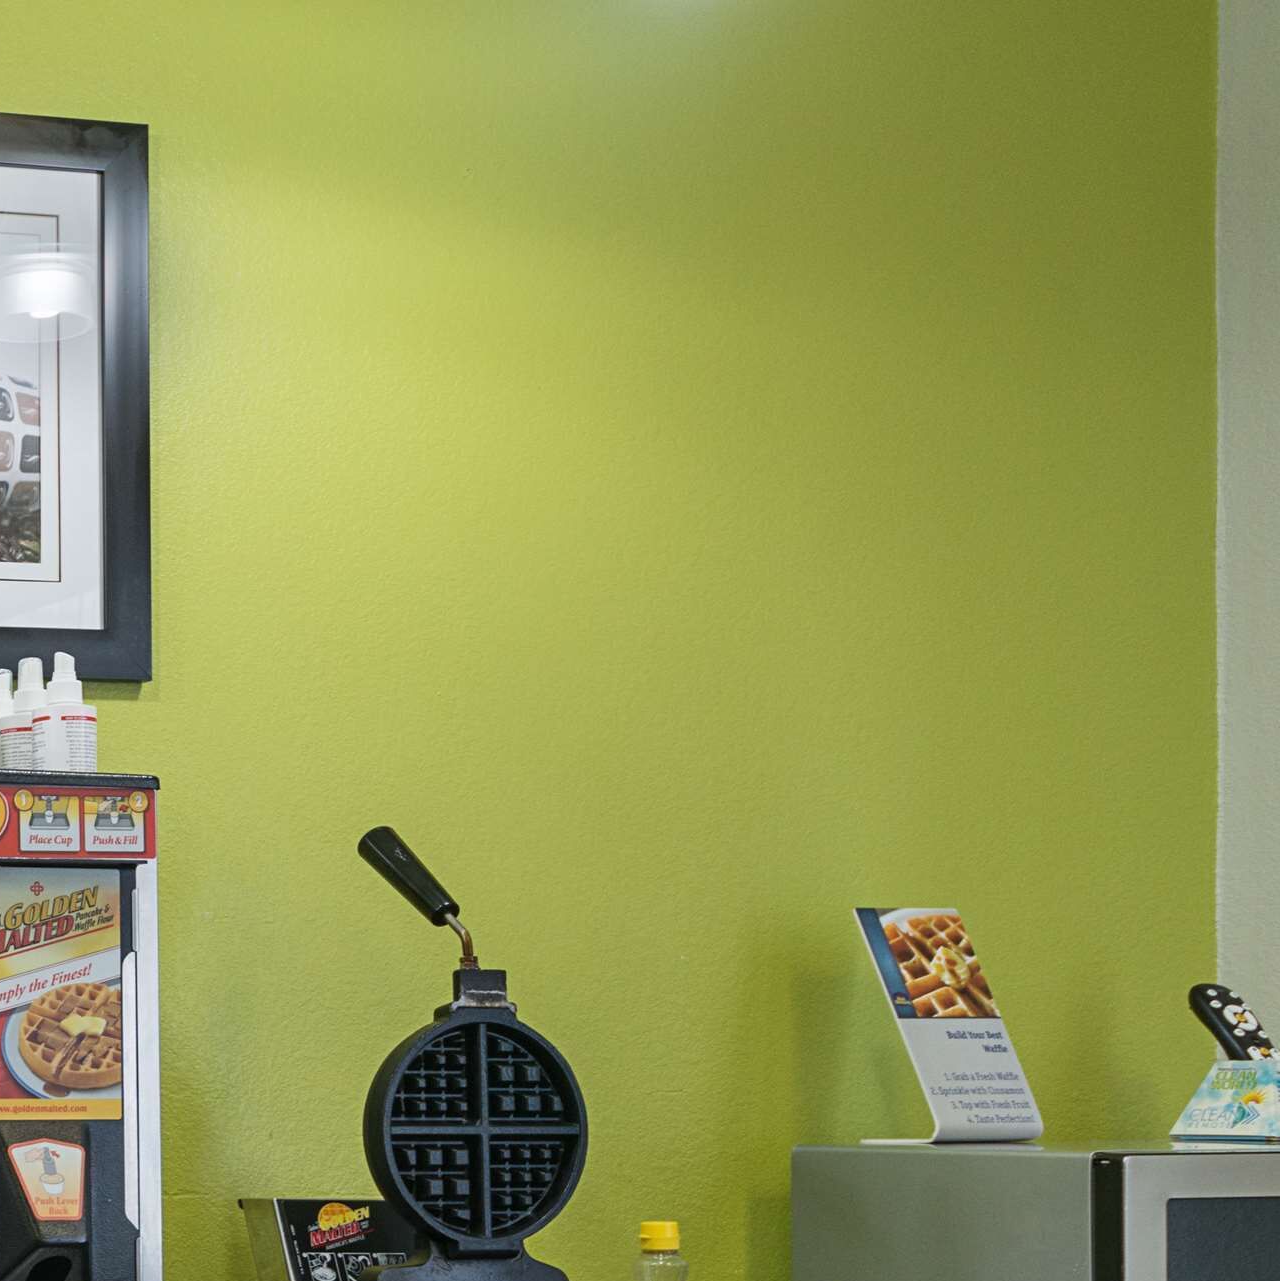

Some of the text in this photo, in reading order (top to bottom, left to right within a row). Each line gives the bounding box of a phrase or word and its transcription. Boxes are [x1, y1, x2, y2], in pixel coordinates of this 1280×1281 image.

[28, 834, 74, 847] Place Cup
[92, 835, 138, 845] Push & Fill
[3, 884, 99, 931] GOLDEN
[75, 906, 103, 921] Pancake
[28, 977, 48, 992] the
[51, 962, 93, 985] Finest!
[945, 1030, 1003, 1040] Build Your Best
[982, 1044, 1009, 1053] Waffle
[975, 1072, 995, 1081] Fresh
[996, 1071, 1019, 1081] Waffle
[938, 1086, 970, 1097] Sprinkle
[970, 1086, 987, 1095] with
[987, 1086, 1025, 1095] Cinnamon
[974, 1100, 990, 1109] with
[1011, 1100, 1031, 1109] Fruit
